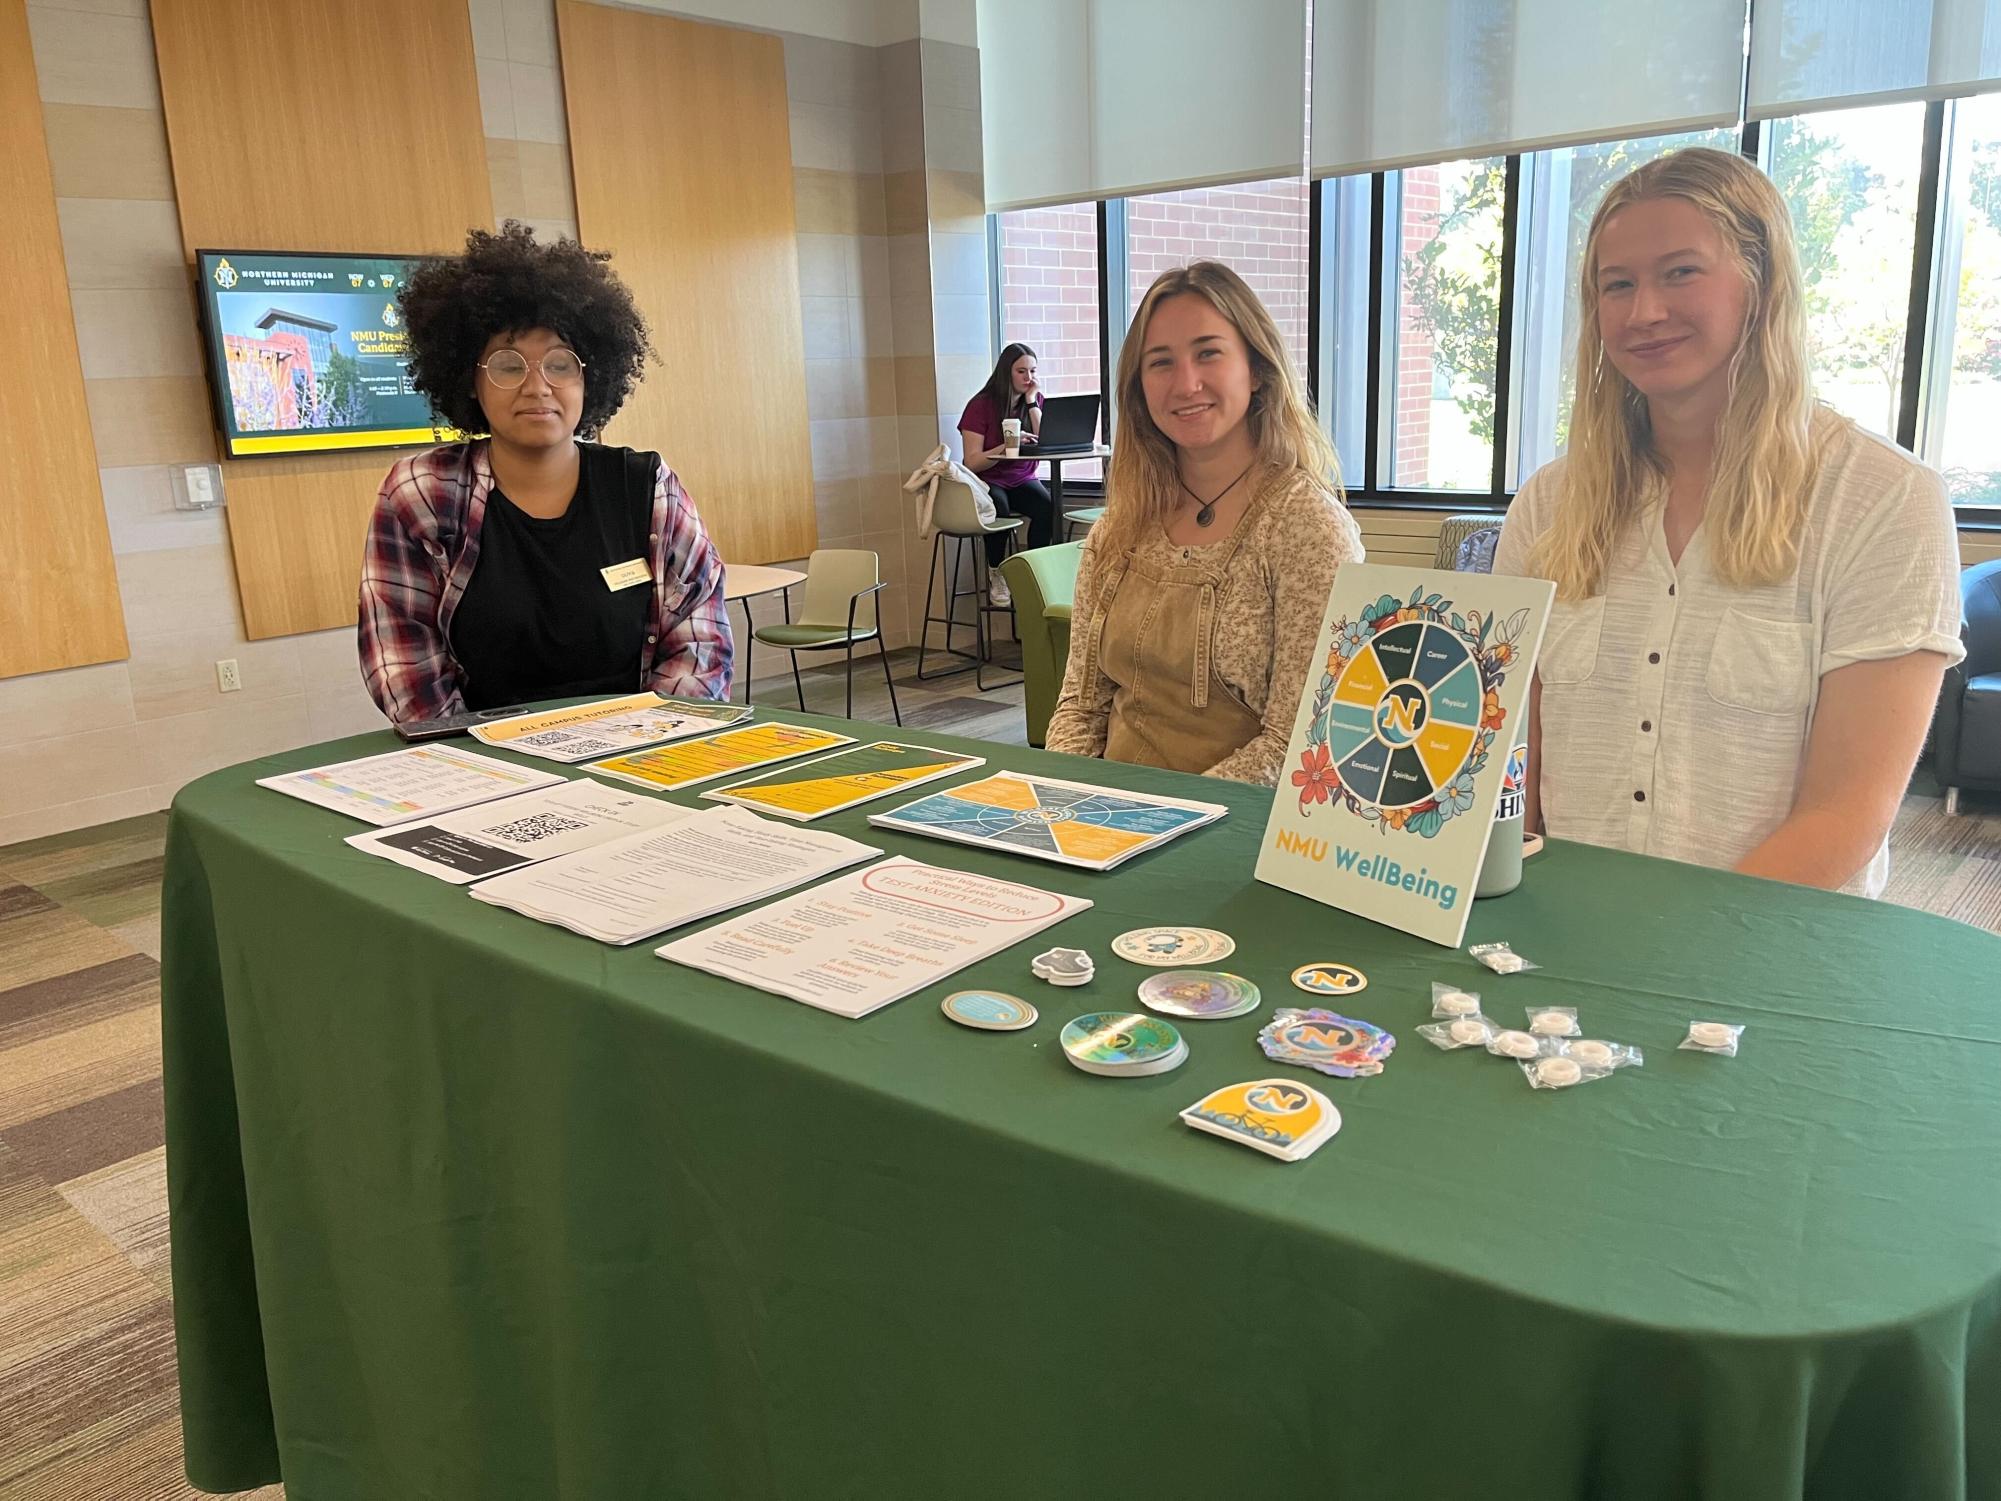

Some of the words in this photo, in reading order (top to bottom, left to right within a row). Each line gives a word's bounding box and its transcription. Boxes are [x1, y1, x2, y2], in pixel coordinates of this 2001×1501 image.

[241, 270, 289, 279] NORTHERN
[291, 271, 334, 279] MICHIGAN
[263, 279, 315, 287] UNIVERSITY
[350, 331, 377, 342] NMU
[1378, 643, 1413, 655] Intellectual
[1426, 650, 1448, 660] Career
[1441, 697, 1469, 709] Physical
[519, 723, 537, 732] ALL
[541, 715, 582, 728] CAMPUS
[584, 705, 633, 719] TUTORING
[1381, 694, 1422, 733] N
[1351, 760, 1380, 773] Emotional
[1391, 770, 1419, 782] Spiritual
[1276, 828, 1328, 863] NMU
[1335, 845, 1458, 910] WellBeing
[879, 876, 912, 889] TEST
[911, 883, 971, 901] ANXIETY
[971, 897, 1032, 917] EDITION
